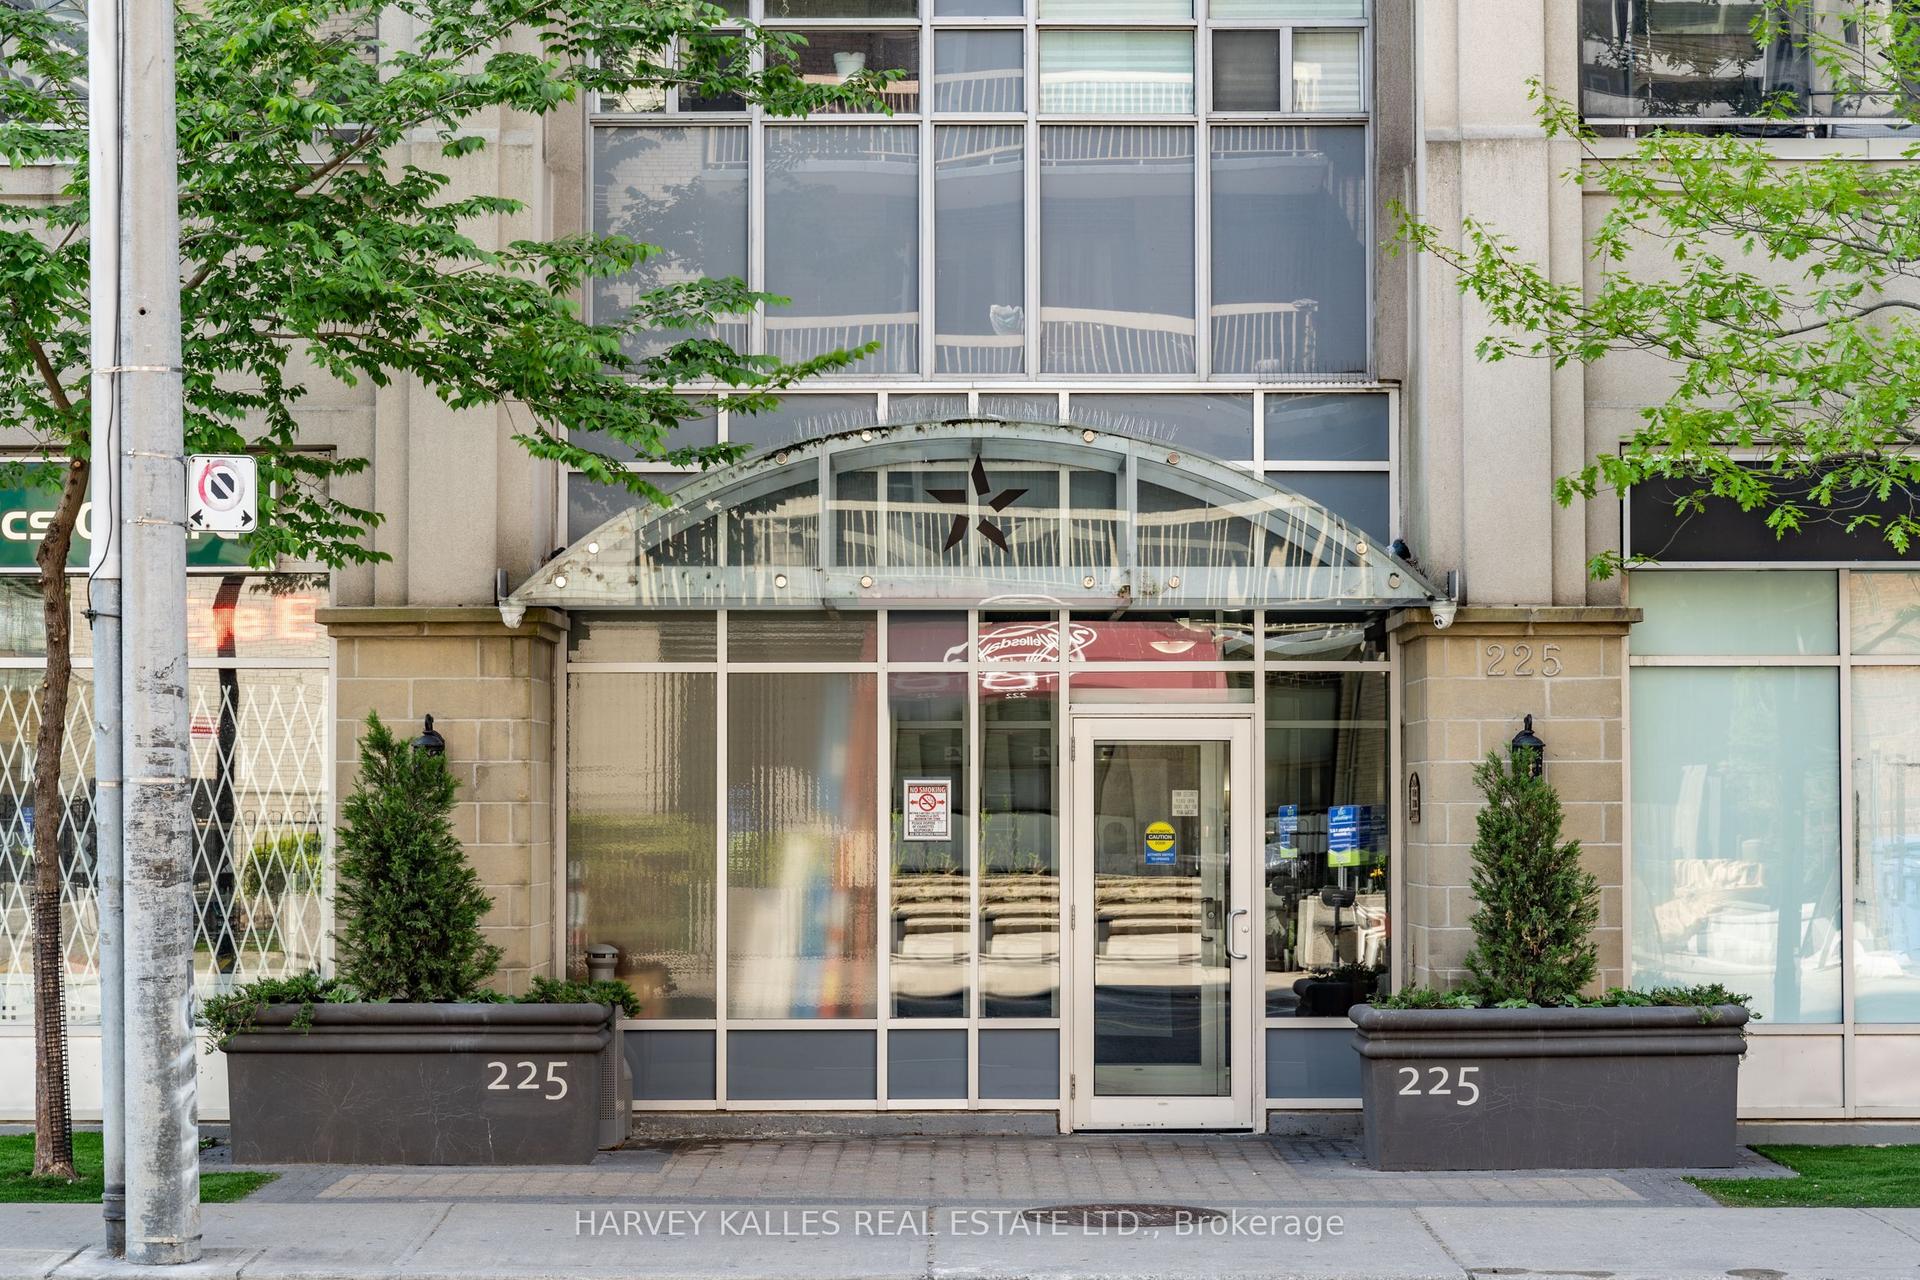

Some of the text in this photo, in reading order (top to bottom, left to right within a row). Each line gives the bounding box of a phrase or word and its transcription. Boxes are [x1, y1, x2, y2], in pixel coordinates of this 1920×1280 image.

[1487, 643, 1563, 677] 225
[486, 1061, 568, 1100] 225
[1398, 1066, 1479, 1106] 225
